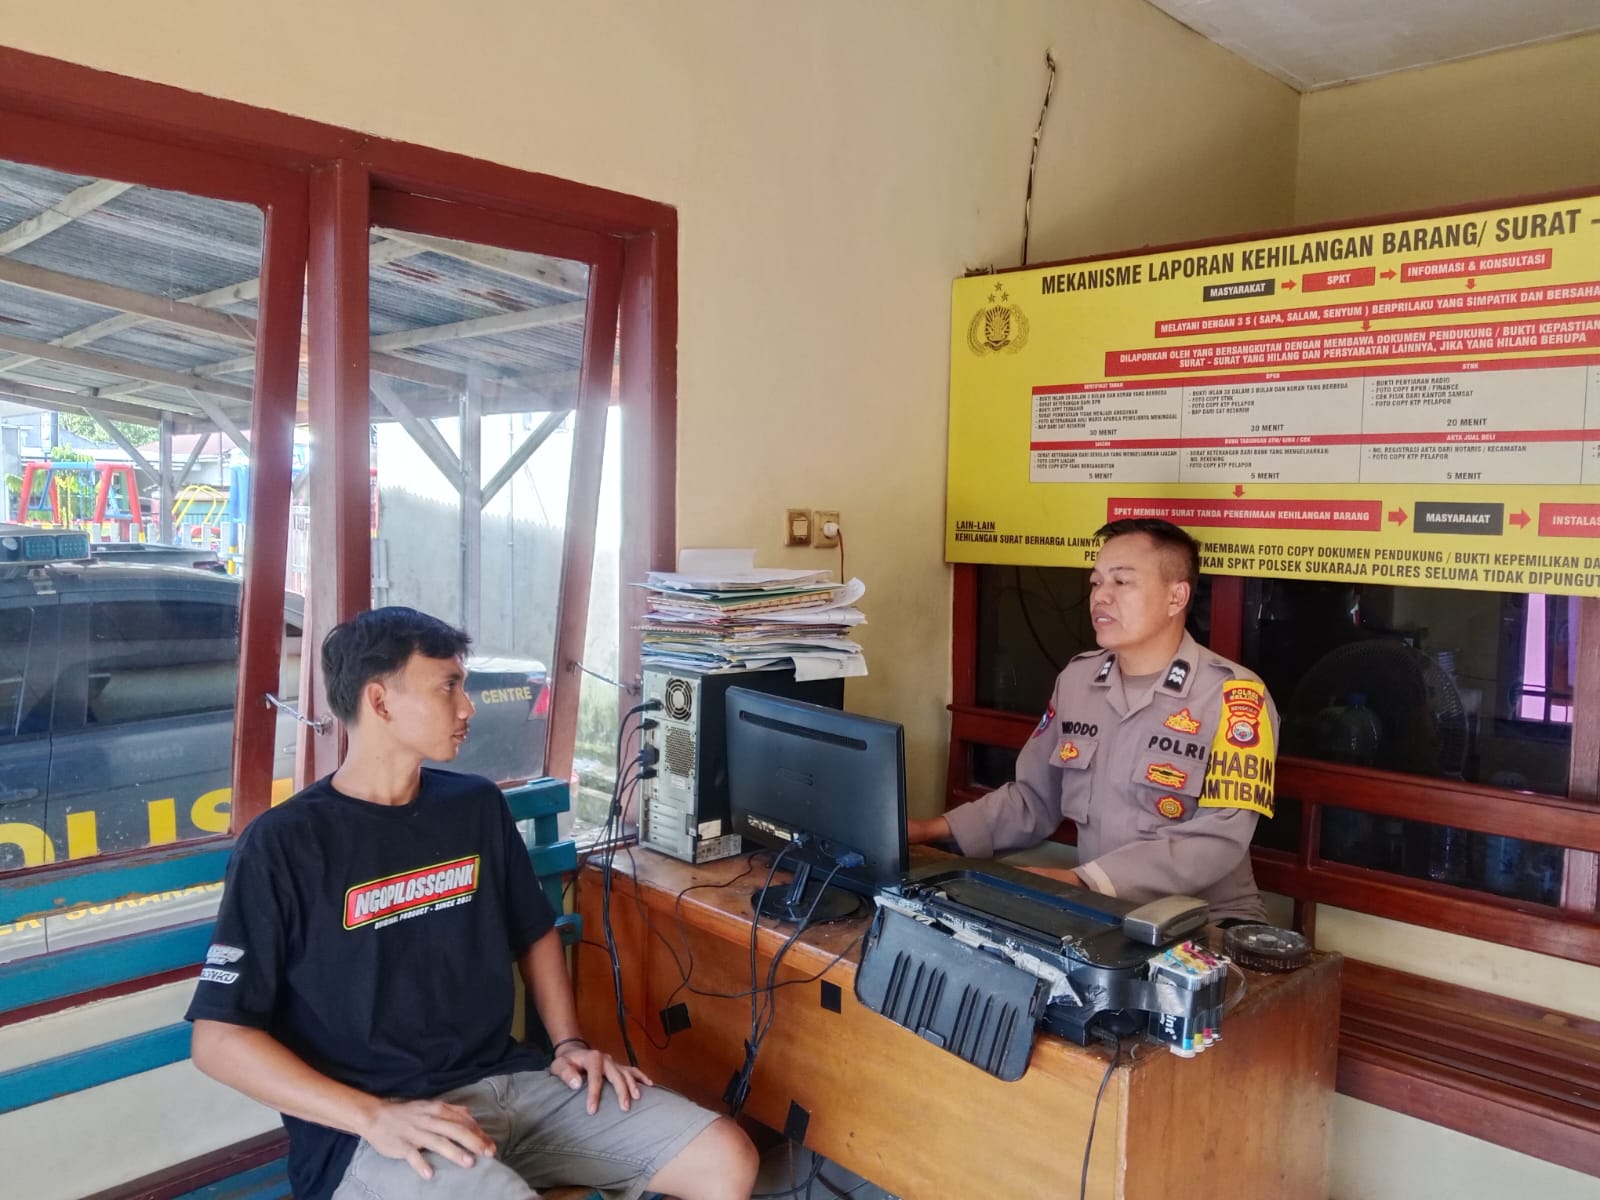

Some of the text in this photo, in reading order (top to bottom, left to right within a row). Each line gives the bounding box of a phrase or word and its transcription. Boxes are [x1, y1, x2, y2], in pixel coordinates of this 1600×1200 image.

[1042, 265, 1141, 295] MEKANISME
[1148, 253, 1233, 282] LAPORAN
[1241, 235, 1374, 272] KEHILANGAN
[1382, 221, 1487, 256] BARANG/
[1496, 209, 1581, 243] SURAT
[1407, 254, 1546, 276] INFORMASI & KONSULTASI
[1327, 274, 1351, 285] SPKT
[1210, 283, 1266, 297] MASYARAKAT
[1161, 321, 1199, 333] MELAYANI
[1201, 318, 1234, 330] DENGAN
[1237, 317, 1242, 327] 3
[1245, 316, 1250, 326] S
[1259, 313, 1283, 325] SAPA,
[1286, 310, 1319, 322] SALAM,
[1323, 306, 1362, 319] SENYUM
[1371, 300, 1433, 315] BERPRILAKU
[1437, 297, 1463, 309] YANG
[1466, 292, 1516, 307] SIMPATIK
[1520, 289, 1543, 302] DAN
[1120, 351, 1167, 363] DILAPORKAN
[1169, 349, 1190, 360] OLEH
[1193, 348, 1213, 358] YANG
[1215, 343, 1281, 356] BERSANGKUTAN
[1284, 340, 1320, 352] DENGAN
[1323, 336, 1373, 349] MEMBAWA
[1376, 332, 1425, 346] DOKUMEN
[1429, 327, 1492, 342] PENDUKUNG
[1502, 324, 1535, 337] BUKTI
[1180, 357, 1204, 368] SURAT
[1213, 354, 1239, 366] SURAT
[1243, 353, 1264, 364] YANG
[1267, 351, 1299, 362] HILANG
[1302, 349, 1320, 360] DAN
[1323, 345, 1389, 359] PERSYARATAN
[1391, 342, 1436, 355] LAINNYA,
[1440, 340, 1462, 352] JIKA
[1466, 338, 1493, 350] YANG
[1496, 335, 1537, 349] HILANG
[1540, 332, 1586, 346] BERUPA
[1460, 418, 1488, 426] MENIT
[1454, 472, 1482, 480] MENIT
[1114, 508, 1370, 521] SPKT MEMBUAT SURAT TANDA PENERIMAAN KEHILANGAN BARANG
[1426, 513, 1491, 524] MASYARAKAT
[956, 521, 995, 531] LAIN-LAIN
[955, 533, 1100, 547] KEHILANGAN SURAT BERHARGA LAINNYA
[1204, 543, 1254, 554] MEMBAWA
[1258, 545, 1283, 556] FOTO
[1287, 546, 1313, 557] COPY
[1317, 547, 1370, 559] DOKUMEN
[1374, 549, 1442, 562] PENDUKUNG
[1454, 552, 1489, 564] BUKTI
[1494, 554, 1578, 568] KEPEMILIKAN
[1227, 558, 1253, 570] SPKT
[1258, 559, 1300, 572] POLSEK
[1305, 561, 1366, 576] SUKARAJA
[1371, 564, 1420, 578] POLRES
[1425, 566, 1477, 581] SELUMA
[1484, 569, 1523, 583] TIDAK
[481, 687, 532, 704] CENTRE
[1148, 736, 1205, 760] POLRI
